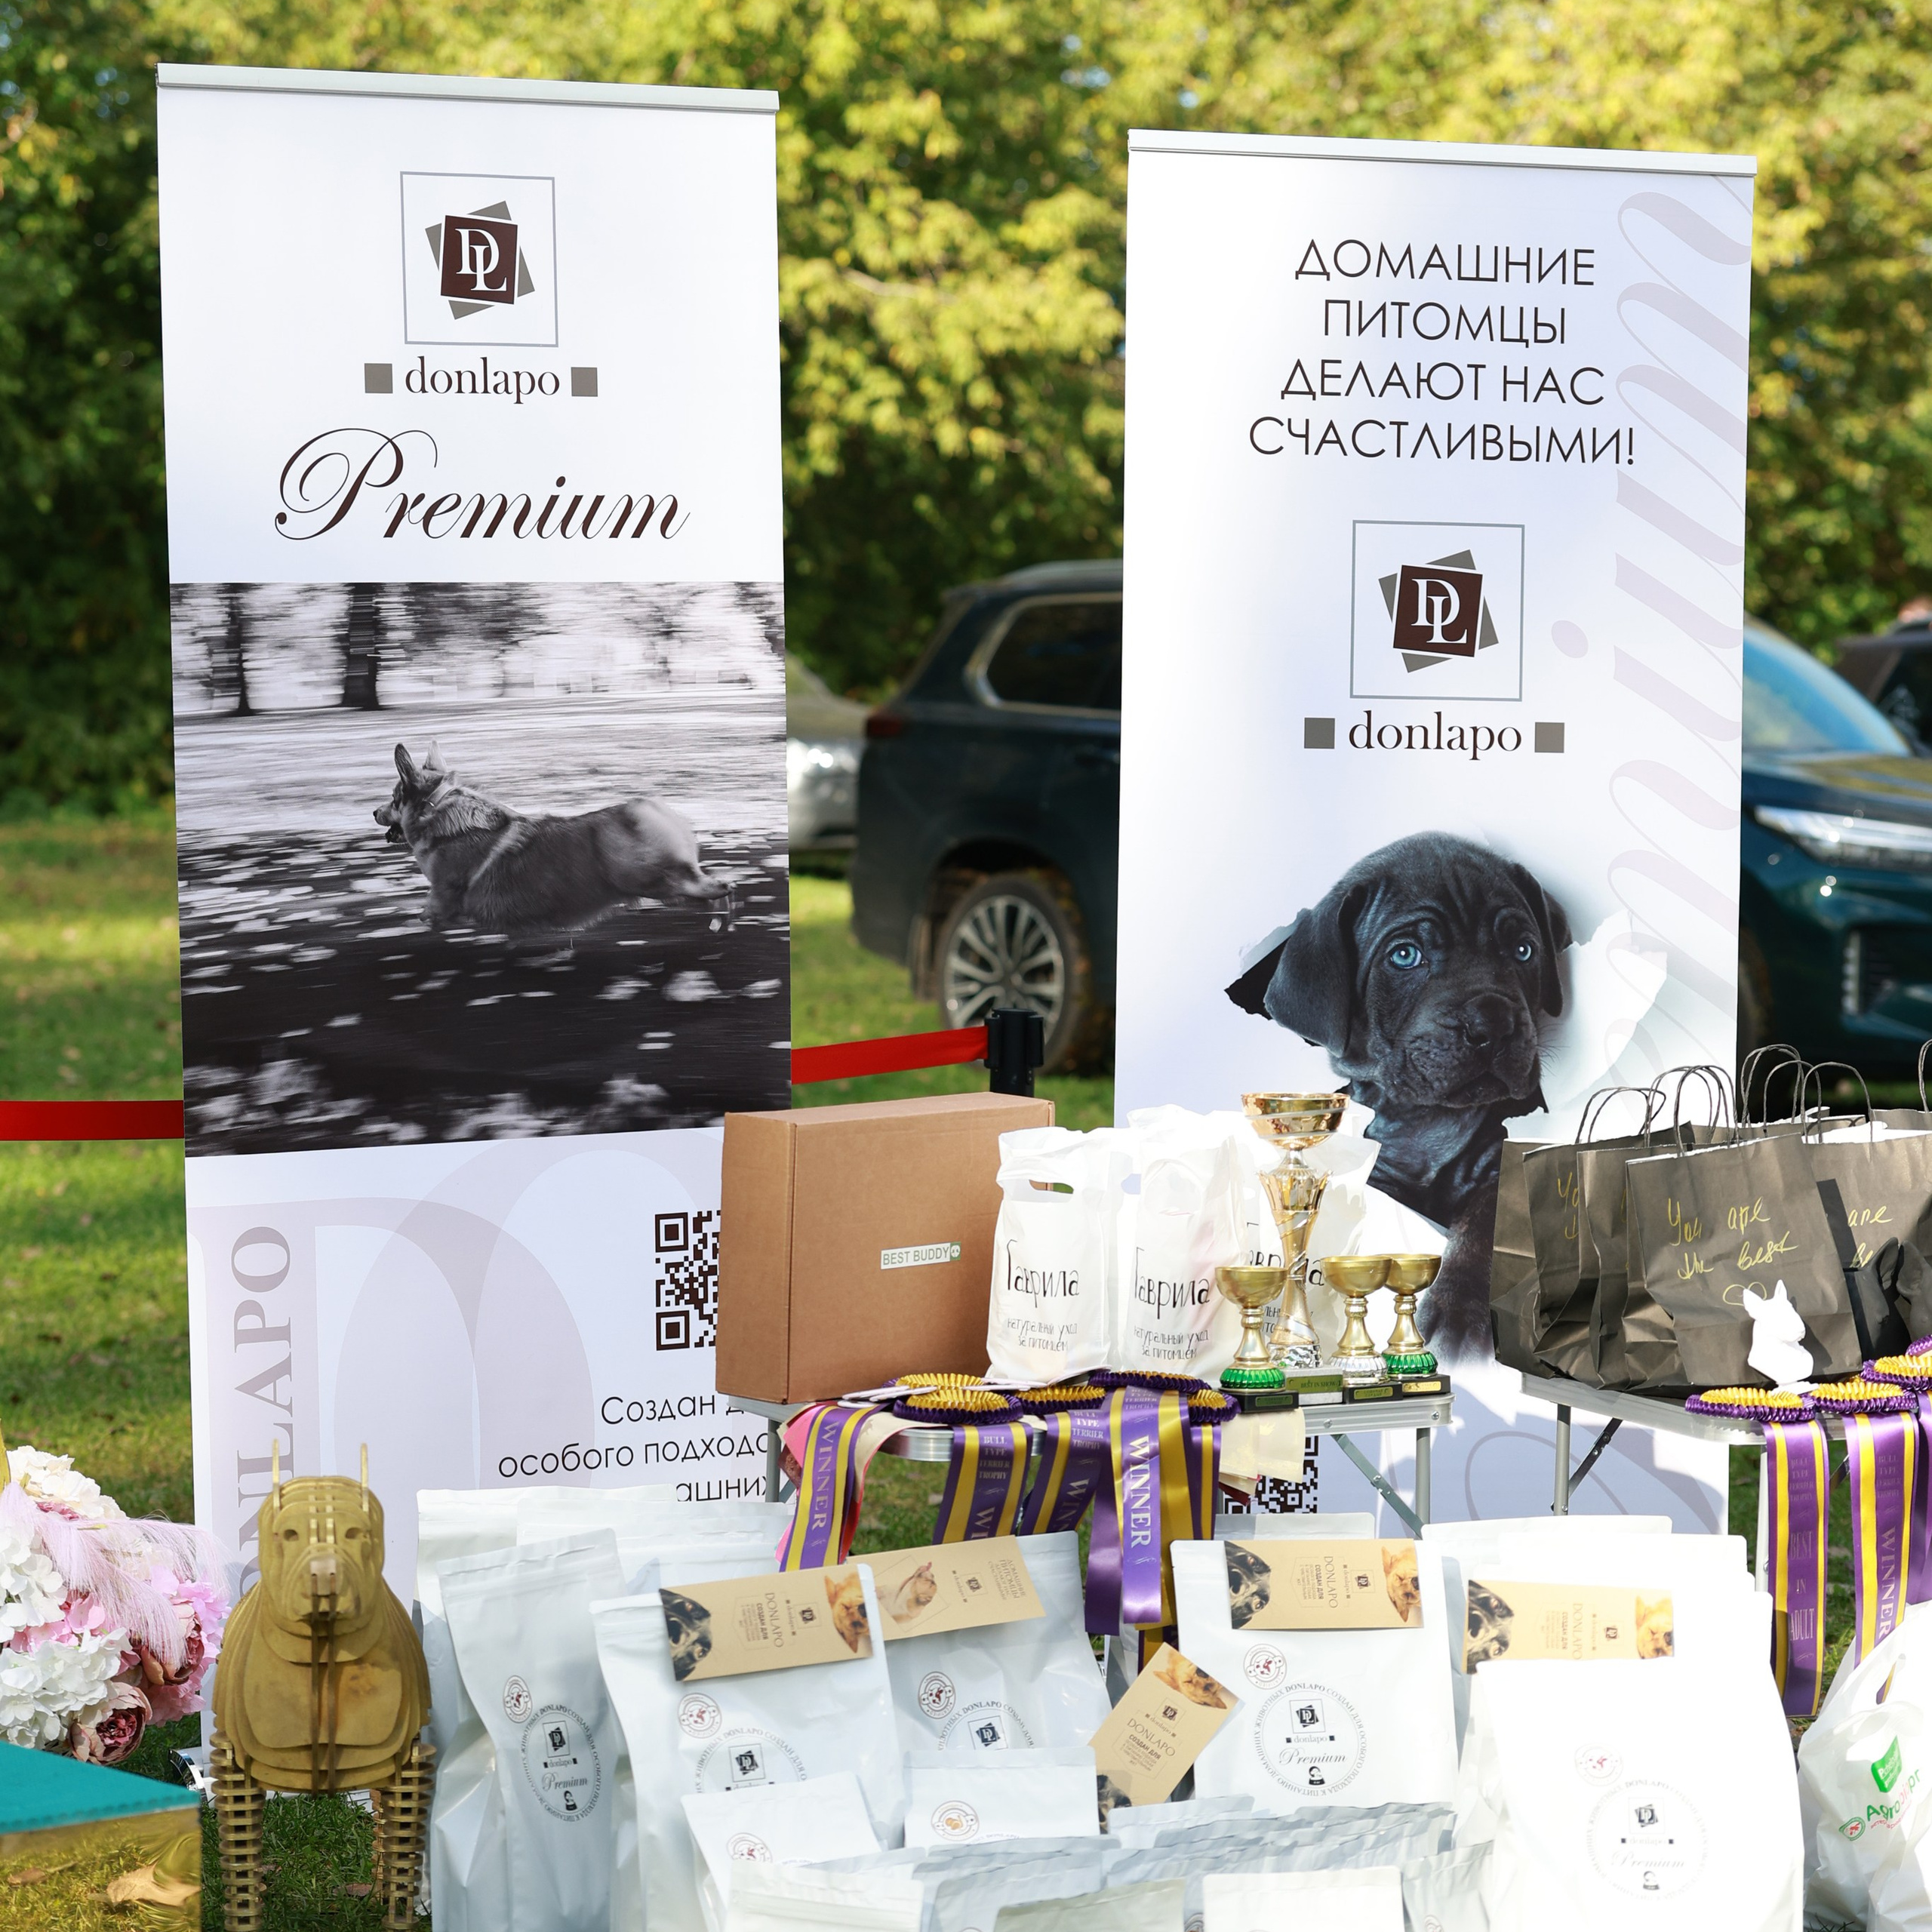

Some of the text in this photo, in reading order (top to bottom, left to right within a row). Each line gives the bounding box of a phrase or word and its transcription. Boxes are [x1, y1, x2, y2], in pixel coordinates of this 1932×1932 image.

[1295, 238, 1595, 285] ДОМАШНИЕ
[1324, 299, 1566, 349] ПИТОМЦЫ
[405, 356, 560, 405] donlapo
[1281, 358, 1605, 405] ДЕЛАЮТ НАС
[1250, 417, 1634, 466] СЧАСТЛИВЫМИ!
[275, 428, 691, 540] Premium
[1349, 710, 1522, 761] donlapo
[1668, 1198, 1702, 1246] You
[883, 1247, 949, 1265] BEST BUDDY
[1737, 1231, 1799, 1271] best
[1850, 1242, 1874, 1268] be
[1007, 1239, 1079, 1308] Гаврила
[1134, 1247, 1210, 1320] Гаврила
[1008, 1318, 1078, 1341] натуральный уход
[1029, 1337, 1069, 1352] питомцем
[1134, 1326, 1209, 1349] натуральный уход
[1152, 1348, 1198, 1361] питомцем
[601, 1395, 715, 1425] Создан
[1076, 1417, 1100, 1427] TYPE
[983, 1435, 1007, 1444] BULL
[1072, 1428, 1104, 1439] TERRIER
[498, 1442, 634, 1478] особого
[812, 1421, 840, 1531] WINNER
[1129, 1435, 1152, 1549] WINNER
[1790, 1531, 1813, 1561] BEST
[1324, 1555, 1339, 1609] DONLAPO
[1796, 1578, 1807, 1594] IN
[1878, 1525, 1896, 1644] WINNER
[764, 1592, 784, 1648] DONLAPO
[1790, 1608, 1815, 1641] ADULT
[1284, 1682, 1325, 1694] DONLAPO
[962, 1700, 1002, 1715] DONLAPO
[722, 1727, 764, 1738] DONLAPO
[1127, 1718, 1176, 1757] DONLAPO
[1128, 1734, 1149, 1752] СОЗДАН
[1148, 1747, 1161, 1760] ДЛЯ
[1294, 1734, 1327, 1744] donlapo
[1278, 1747, 1347, 1766] Premium
[541, 1772, 589, 1792] Premium
